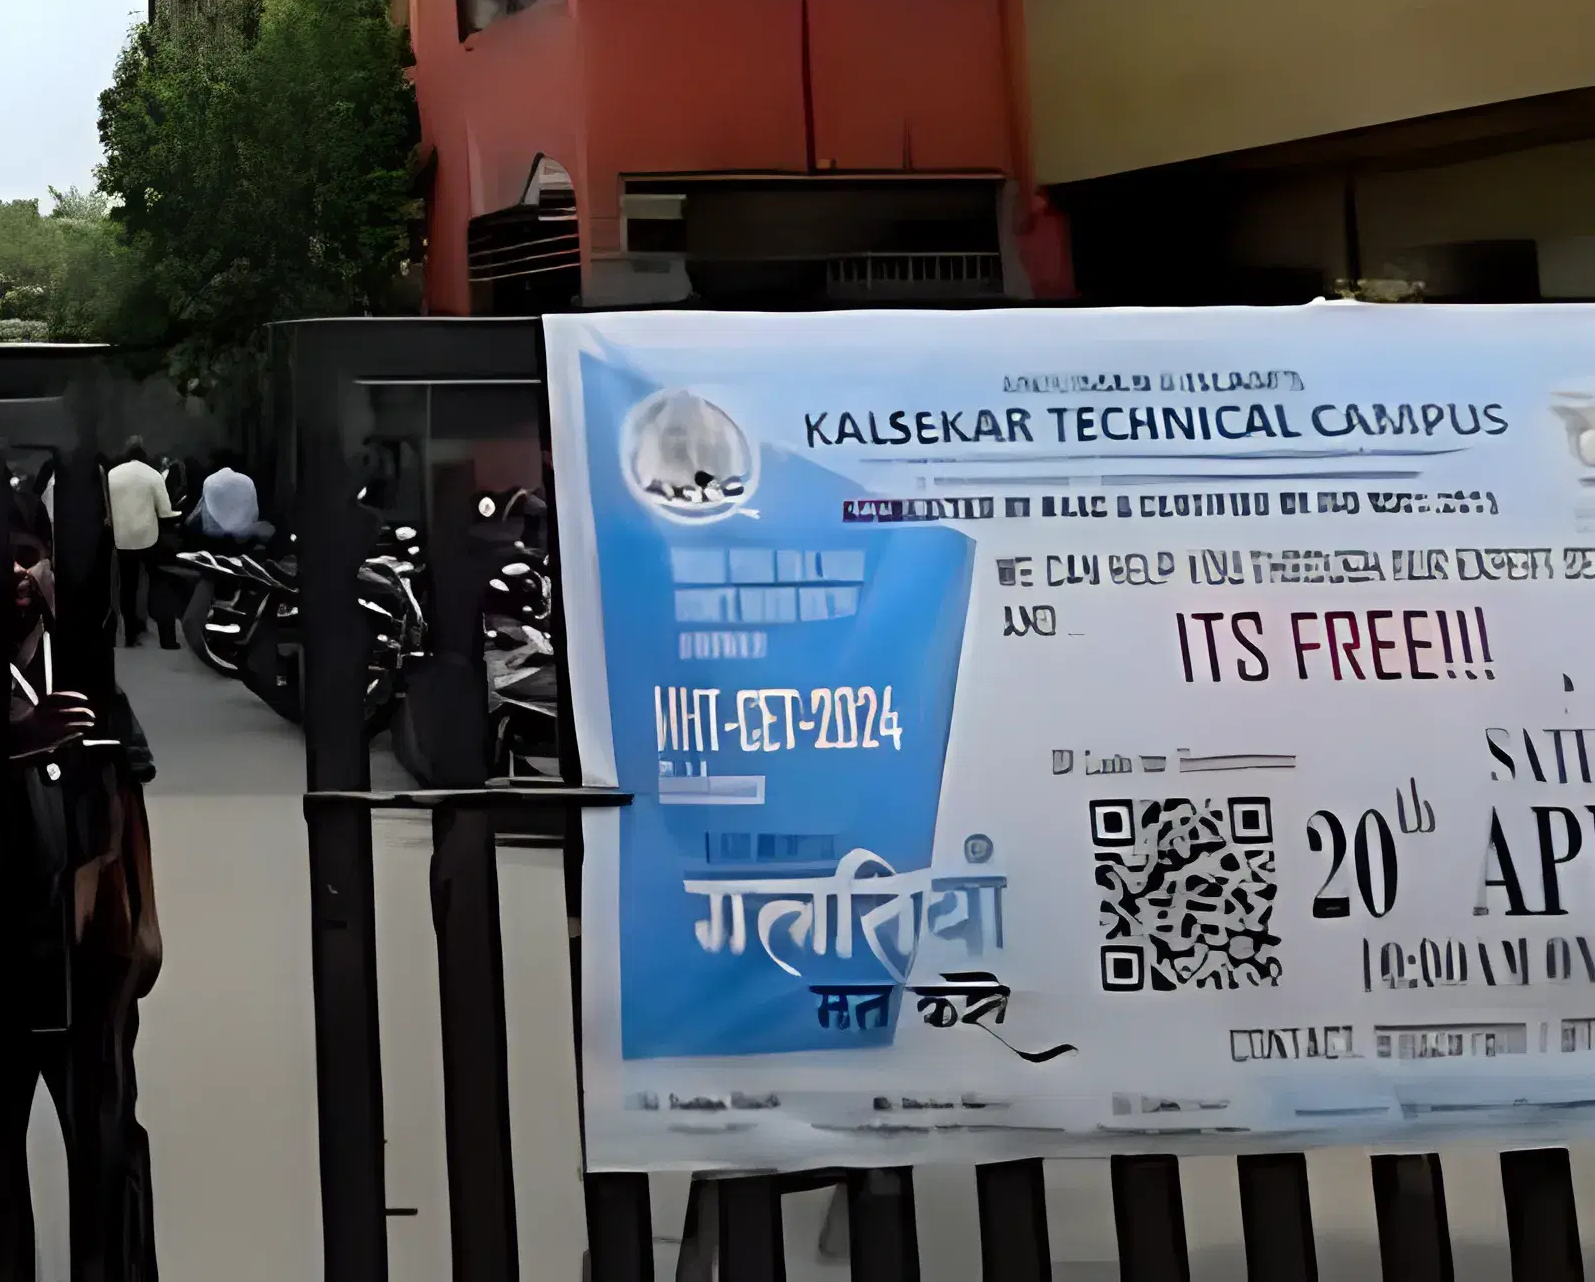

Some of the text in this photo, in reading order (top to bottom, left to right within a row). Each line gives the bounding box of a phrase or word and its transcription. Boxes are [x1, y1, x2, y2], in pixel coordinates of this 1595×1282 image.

[804, 402, 1509, 448] KALSEKAR TECHNICAL CAMPUS
[1176, 606, 1496, 683] ITS FREE!!!
